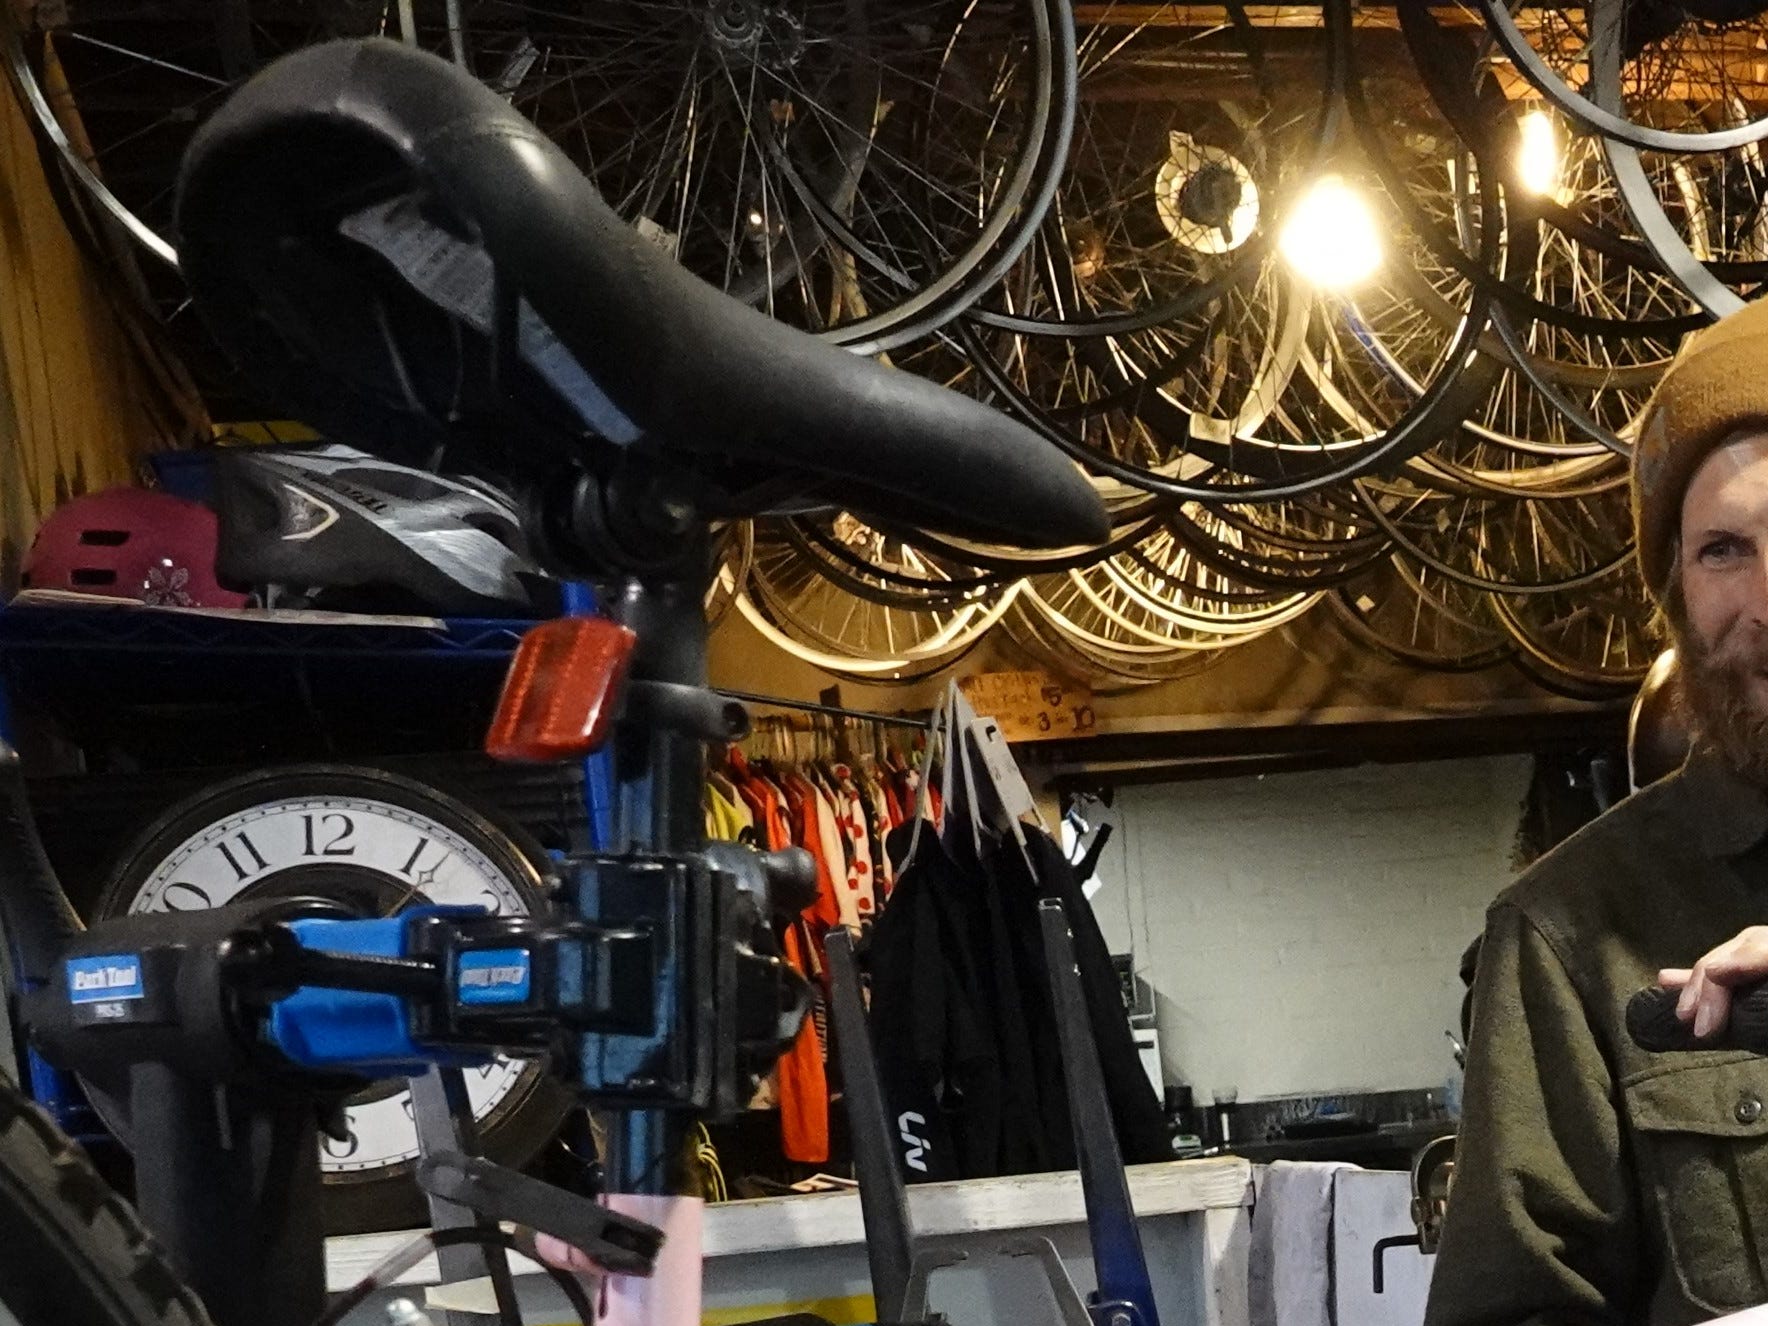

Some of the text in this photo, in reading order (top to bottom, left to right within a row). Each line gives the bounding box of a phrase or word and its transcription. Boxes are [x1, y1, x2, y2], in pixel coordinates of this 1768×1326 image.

[215, 831, 271, 881] 11
[302, 814, 357, 857] 12
[400, 836, 429, 878] 1
